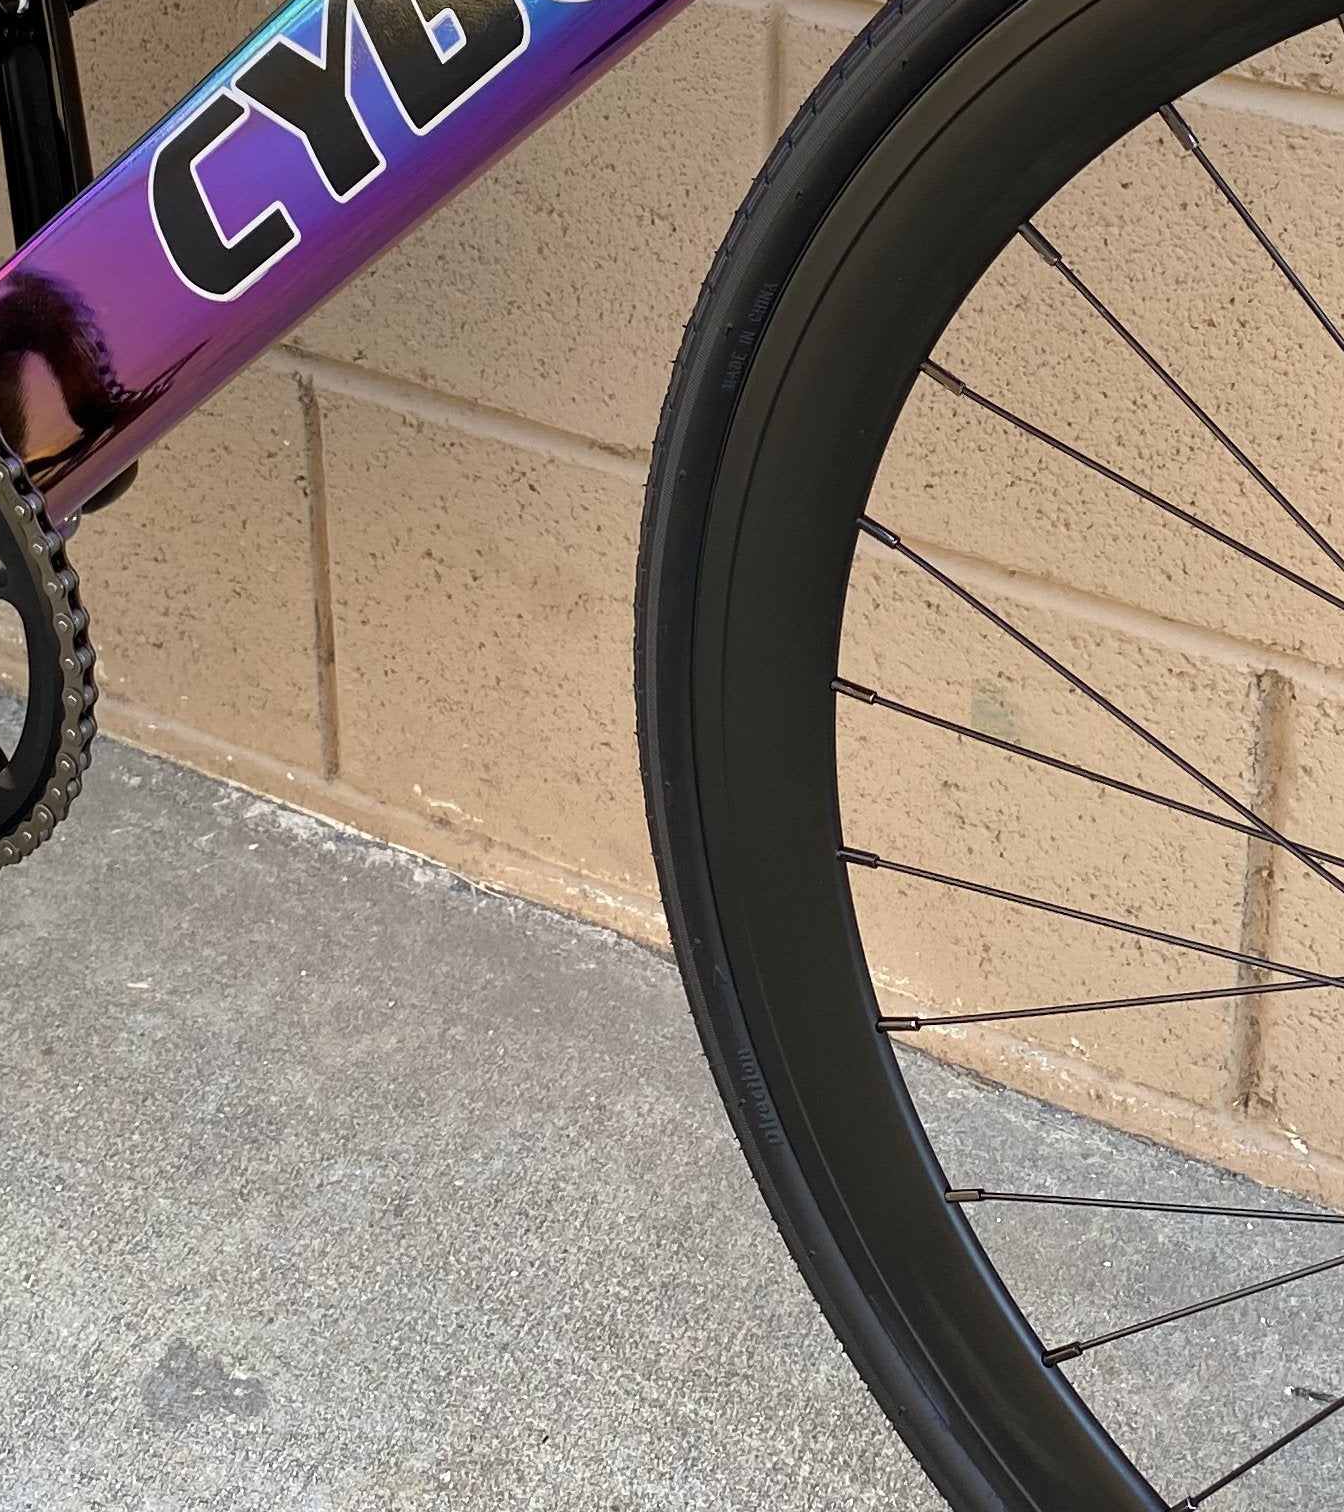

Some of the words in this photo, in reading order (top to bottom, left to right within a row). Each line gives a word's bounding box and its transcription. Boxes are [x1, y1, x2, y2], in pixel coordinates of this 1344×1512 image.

[722, 351, 748, 392] MADE
[737, 329, 755, 347] IN
[748, 283, 778, 323] CHINA
